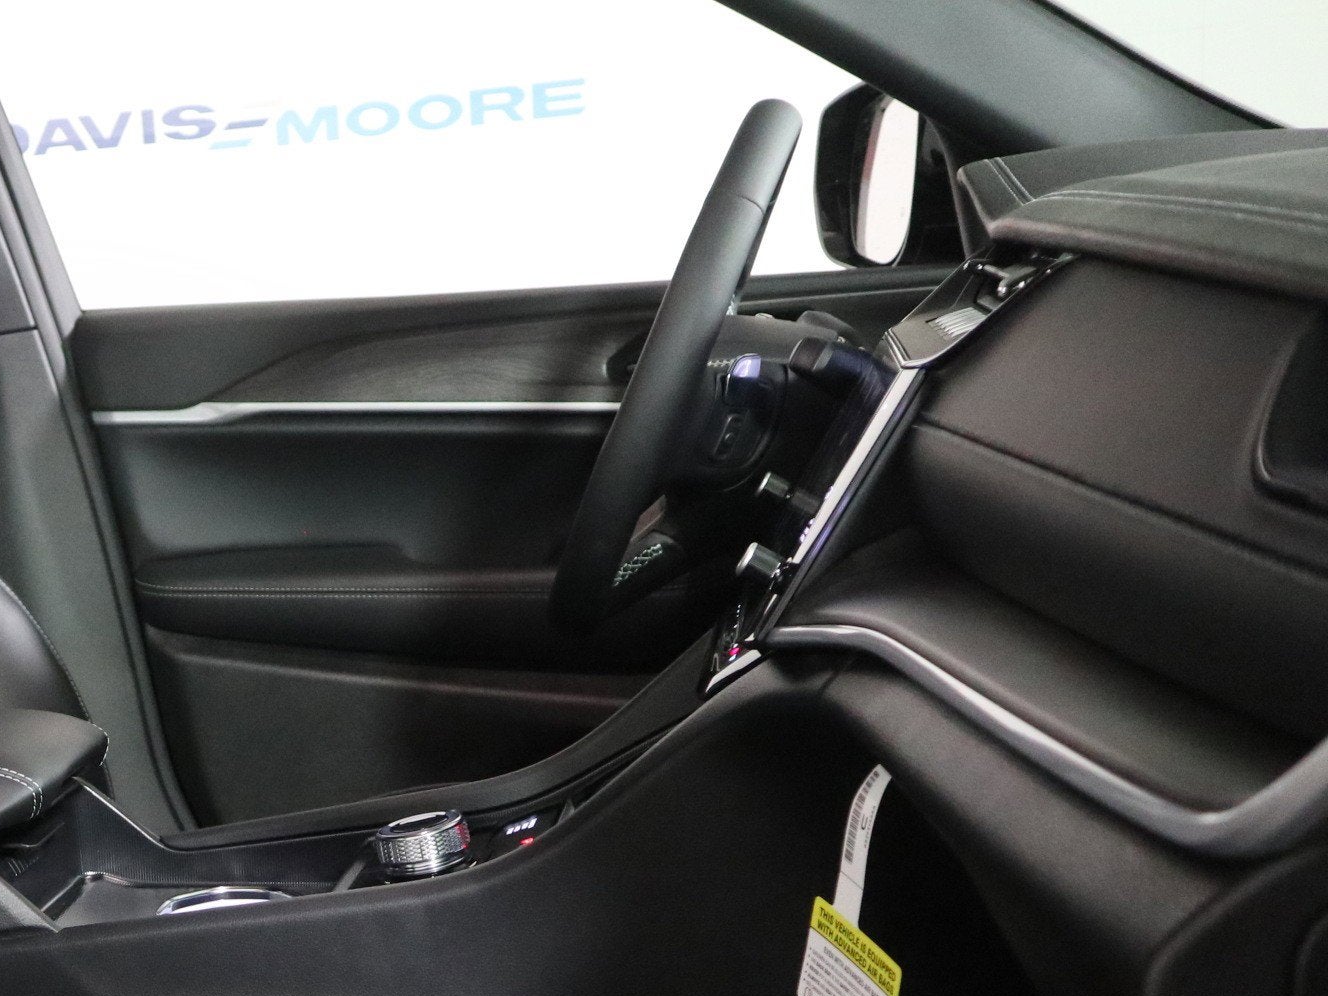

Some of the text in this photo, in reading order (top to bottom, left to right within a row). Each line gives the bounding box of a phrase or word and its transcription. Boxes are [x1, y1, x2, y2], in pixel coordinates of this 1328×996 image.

[817, 919, 894, 995] WITH ADVANCED AIR BAGS
[819, 907, 896, 981] THIS VEHICLE IS EQUIPPED
